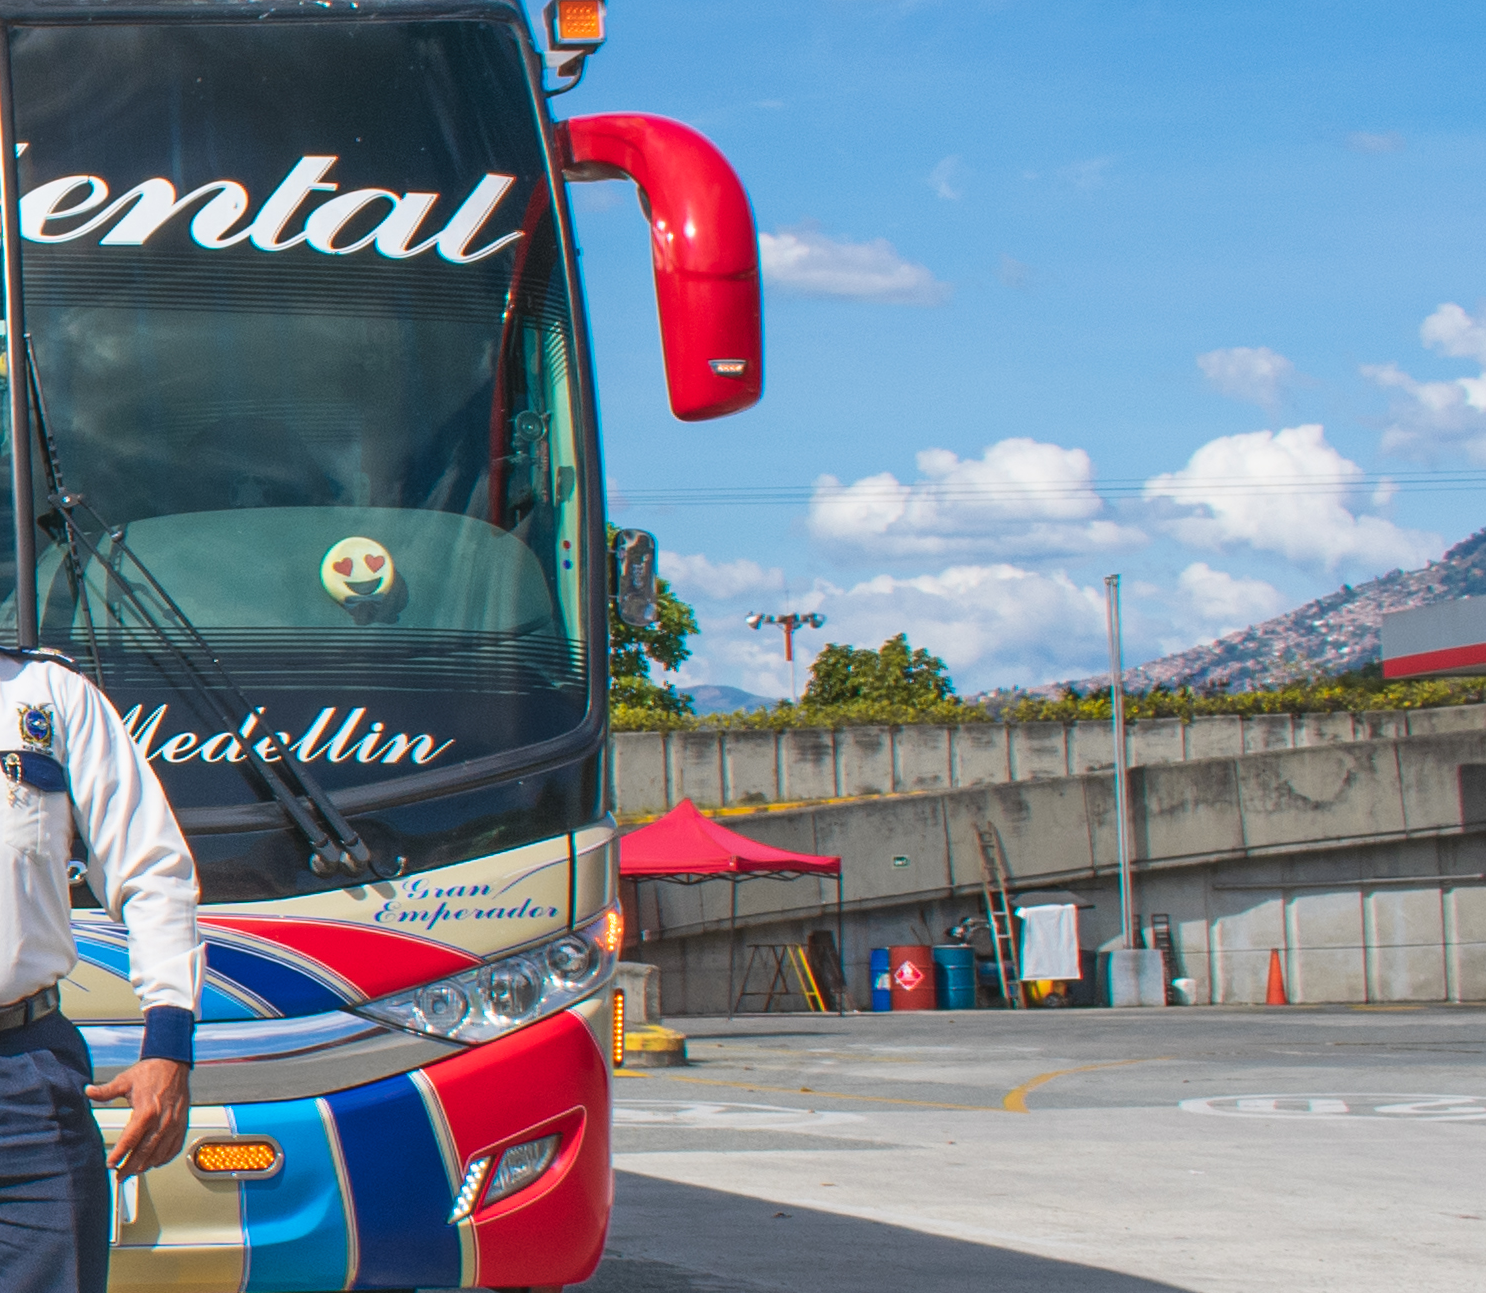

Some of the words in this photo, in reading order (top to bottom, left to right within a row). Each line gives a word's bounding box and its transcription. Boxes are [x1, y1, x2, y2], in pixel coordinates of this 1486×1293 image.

[122, 703, 456, 765] Medellin
[402, 878, 494, 900] Gran
[374, 898, 560, 930] Emperador
